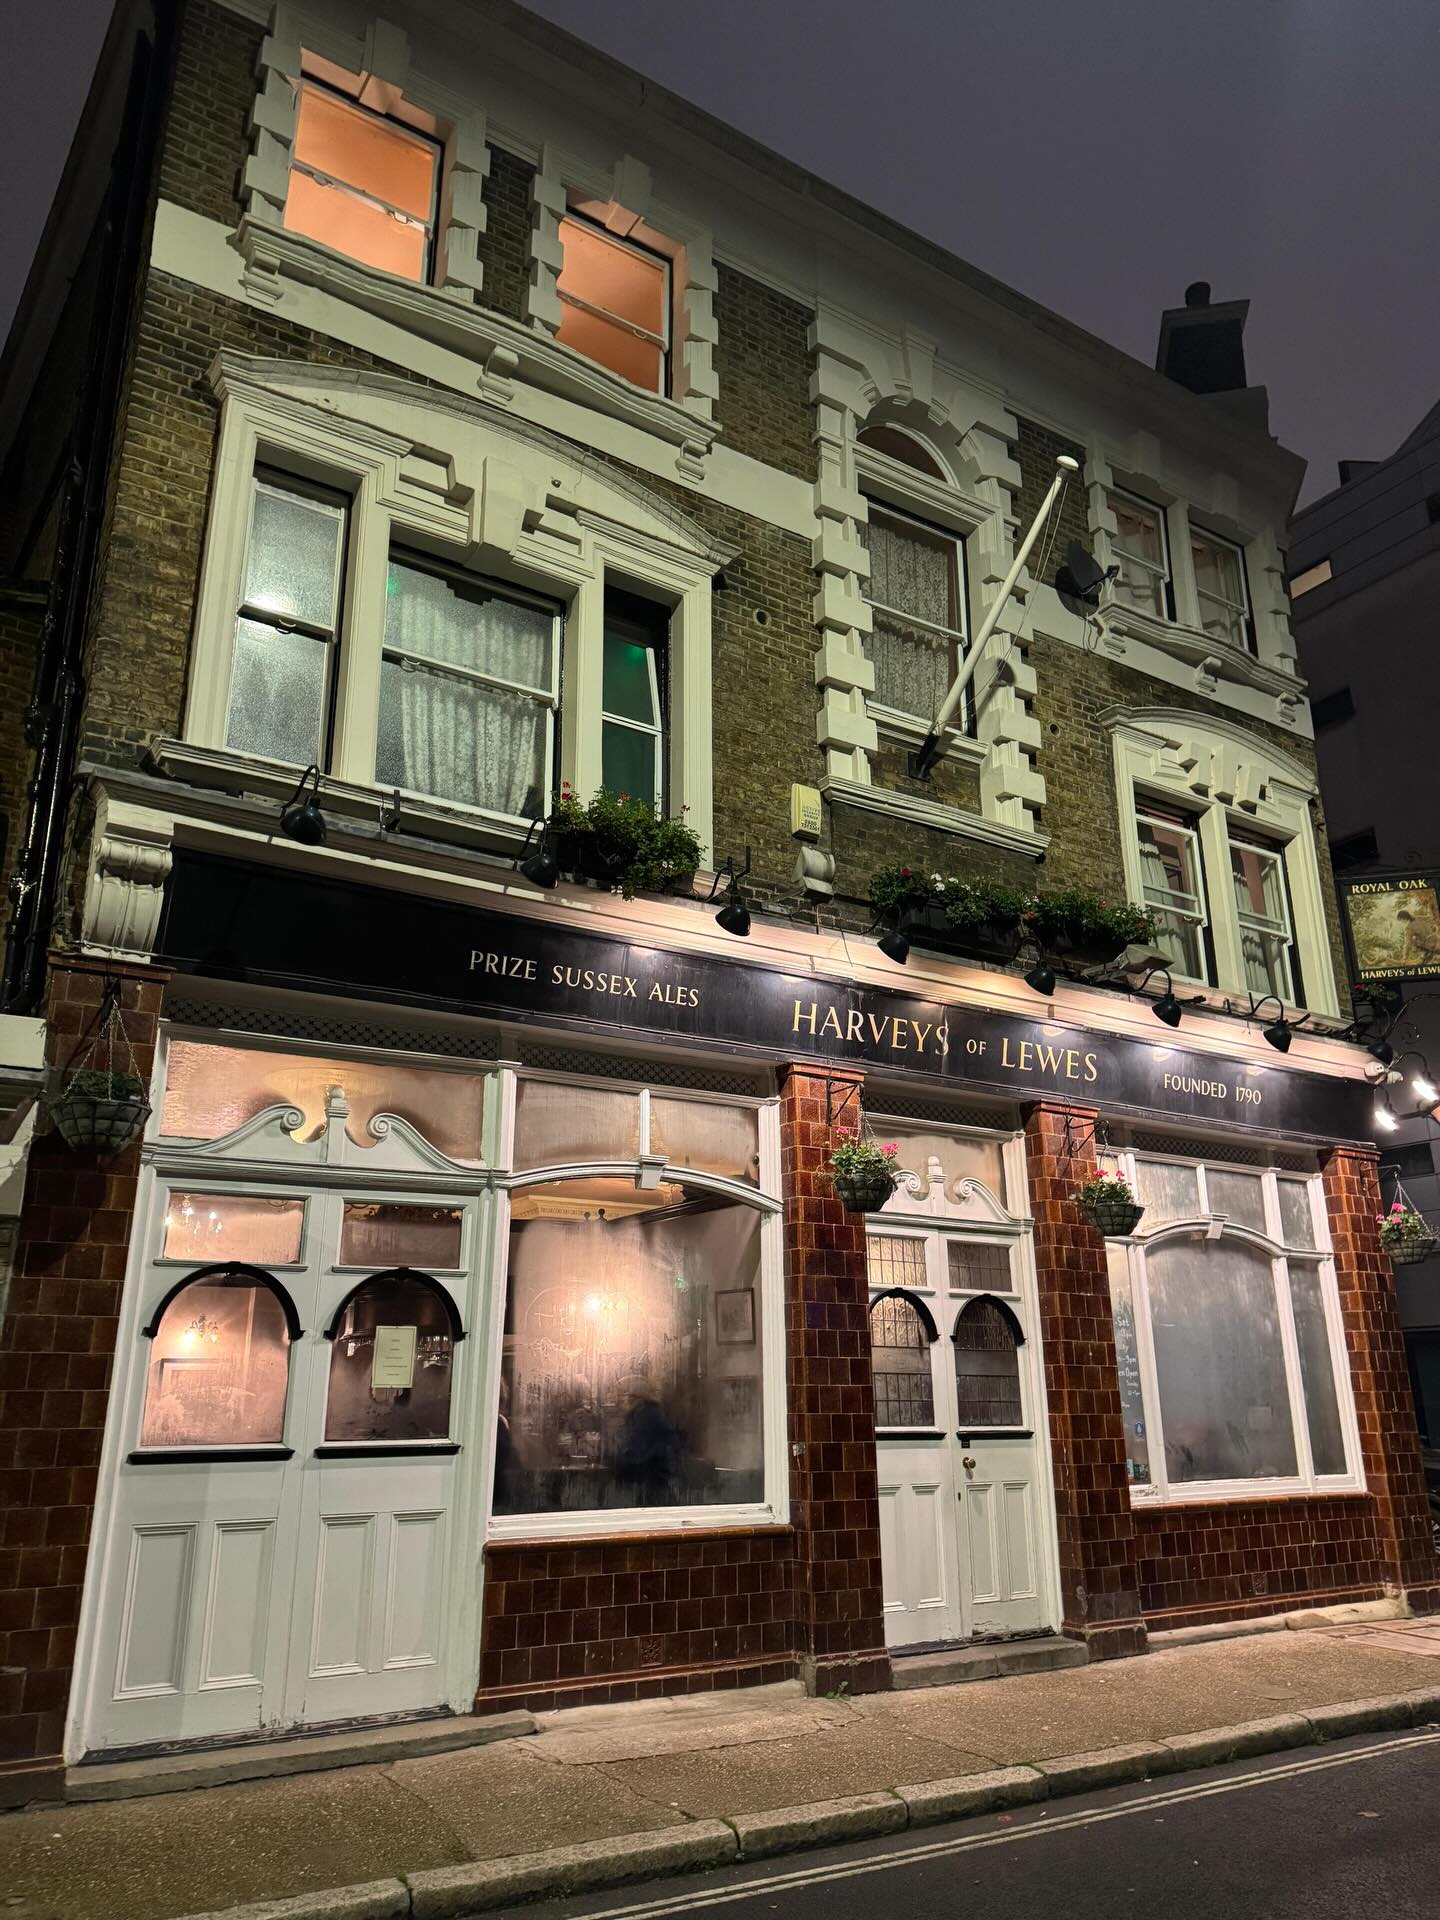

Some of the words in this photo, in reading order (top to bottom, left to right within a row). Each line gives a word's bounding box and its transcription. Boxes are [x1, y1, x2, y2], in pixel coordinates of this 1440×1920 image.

[1352, 882, 1393, 894] ROYAL
[1399, 879, 1427, 890] OAK
[469, 950, 538, 980] PRIZE
[551, 965, 638, 998] SUSSEX
[648, 982, 699, 1007] ALES
[1361, 968, 1405, 979] HARVEYS
[1407, 967, 1415, 976] of
[792, 1000, 949, 1056] HARVEYS
[966, 1039, 987, 1056] OF
[1001, 1037, 1098, 1082] LEWES
[1164, 1073, 1227, 1099] FOUNDED
[1235, 1086, 1262, 1105] 1790
